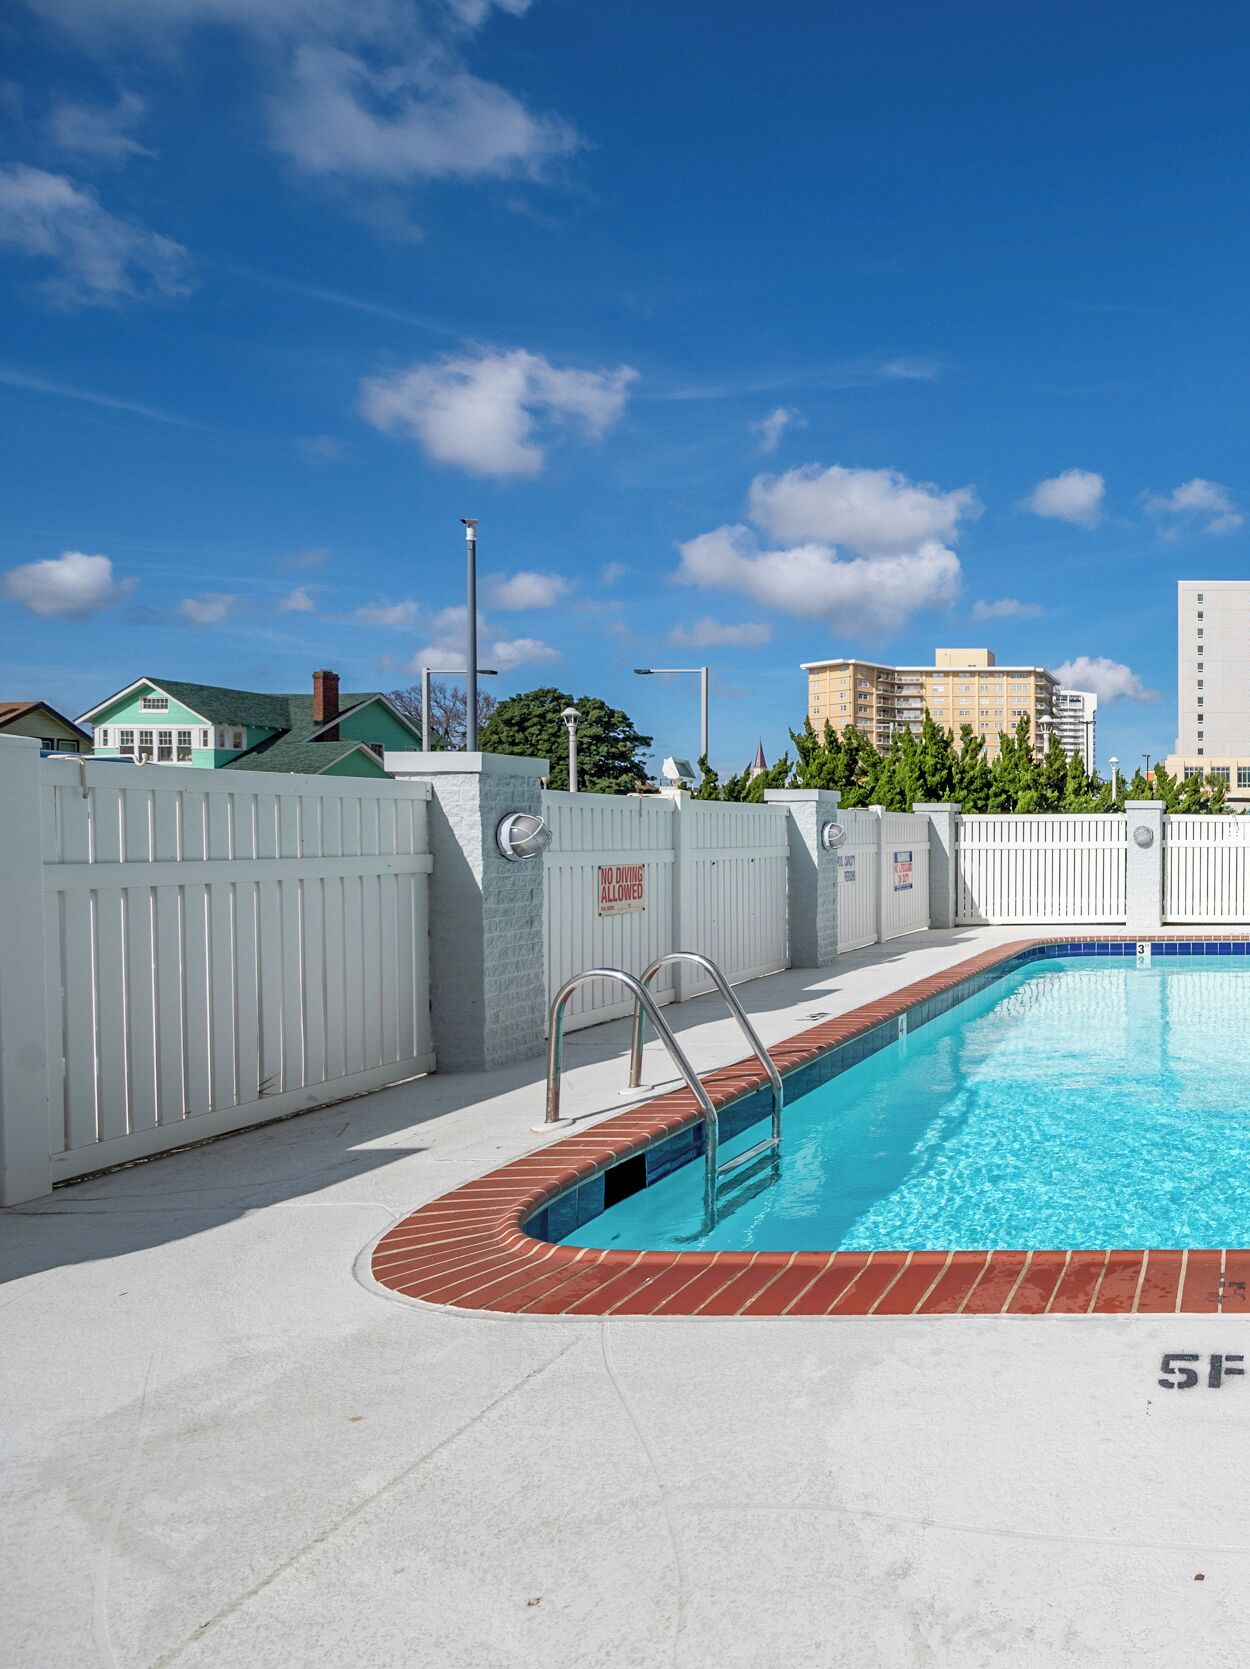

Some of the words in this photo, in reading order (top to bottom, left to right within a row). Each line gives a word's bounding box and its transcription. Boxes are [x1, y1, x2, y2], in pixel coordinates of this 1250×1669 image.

[601, 867, 613, 885] NO
[616, 866, 642, 884] DIVING
[601, 883, 642, 903] ALLOWED
[1138, 944, 1144, 954] 3
